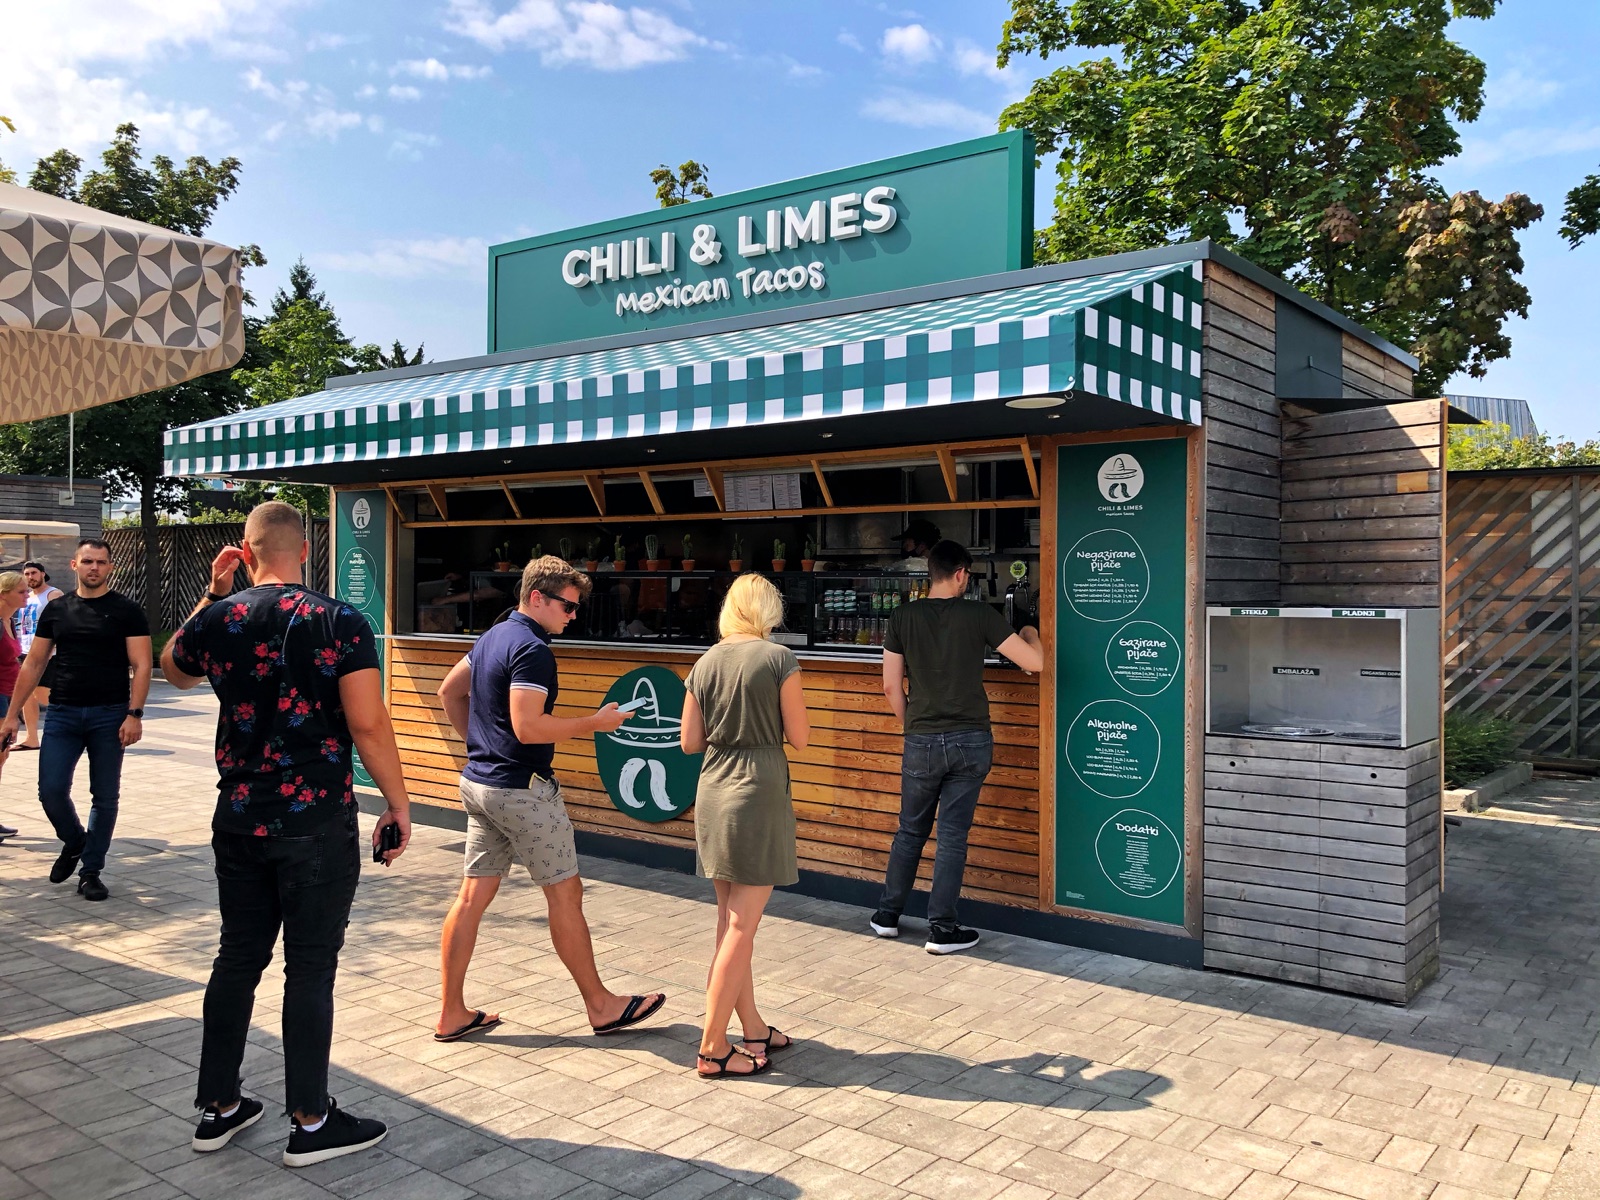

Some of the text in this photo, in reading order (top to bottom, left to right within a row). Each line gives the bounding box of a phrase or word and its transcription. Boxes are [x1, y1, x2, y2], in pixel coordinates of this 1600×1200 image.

[562, 185, 898, 288] CHILI & LIMES
[616, 261, 826, 317] Mexican Tacos
[1076, 549, 1137, 561] Negazirane
[1091, 559, 1122, 572] pijače
[1118, 637, 1168, 651] Gazirane
[1126, 648, 1159, 660] pijače
[1277, 667, 1315, 676] EMBALAŽA
[1087, 718, 1138, 732] Alkoholne
[1096, 729, 1128, 742] pijače
[1115, 822, 1159, 836] Dodatki
